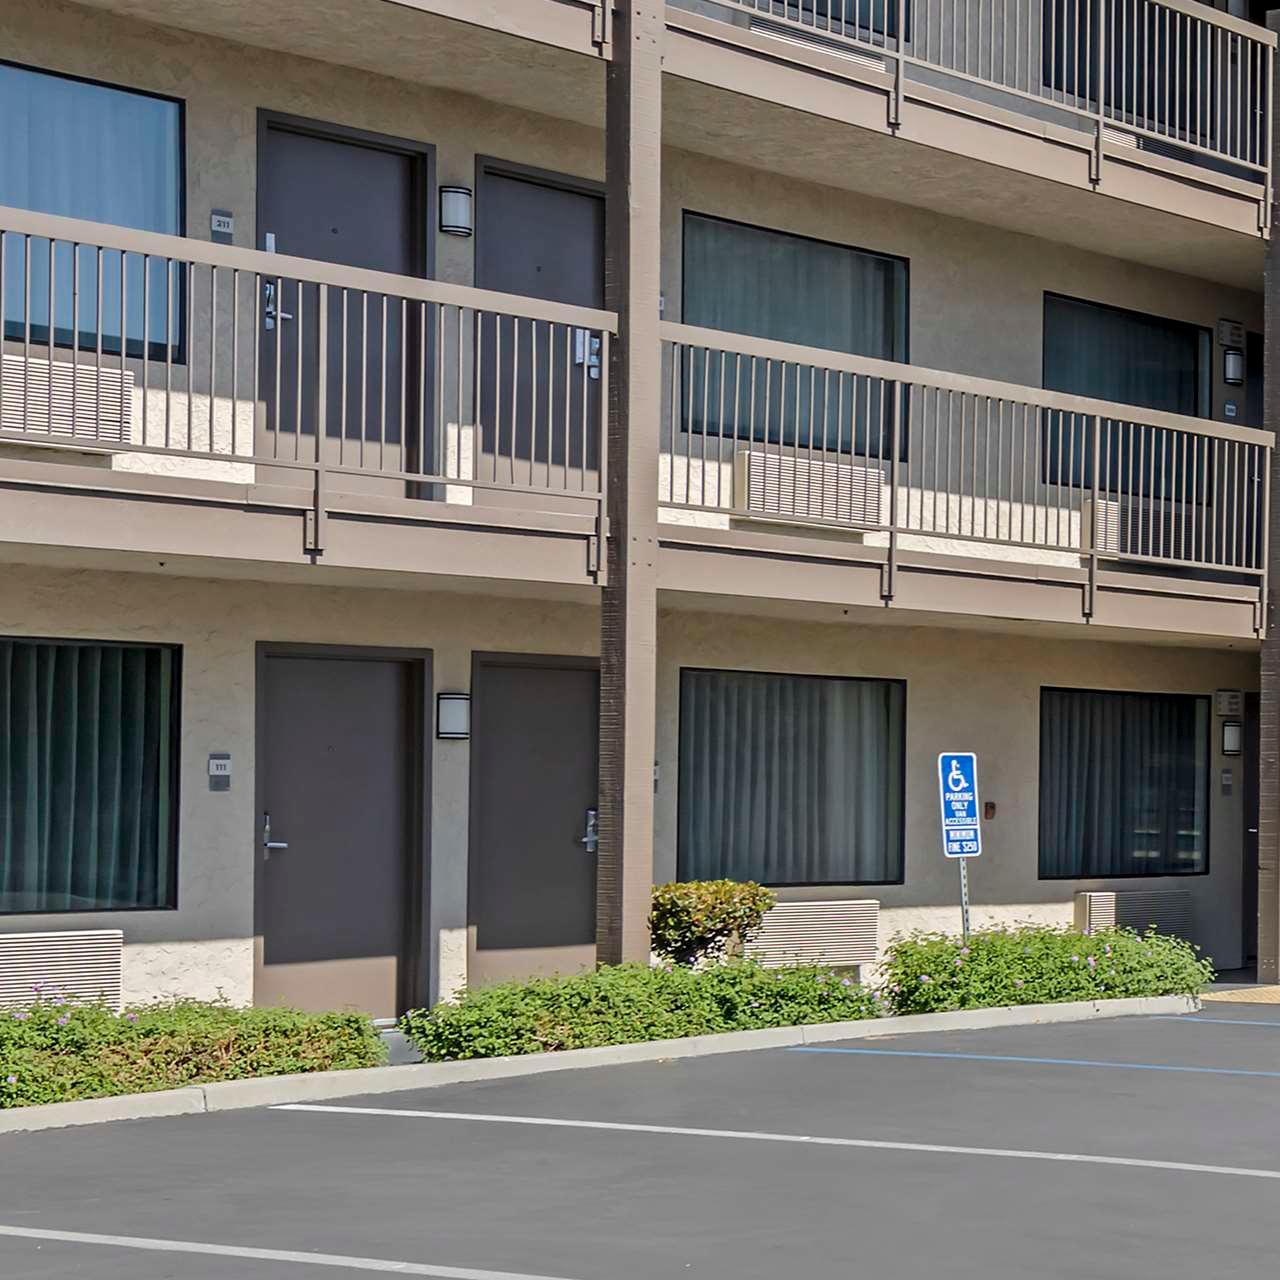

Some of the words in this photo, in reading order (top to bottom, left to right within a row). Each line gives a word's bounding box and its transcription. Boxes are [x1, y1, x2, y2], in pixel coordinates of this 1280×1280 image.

[215, 763, 226, 771] 111
[945, 792, 973, 801] PARKING
[951, 801, 968, 810] ONLY
